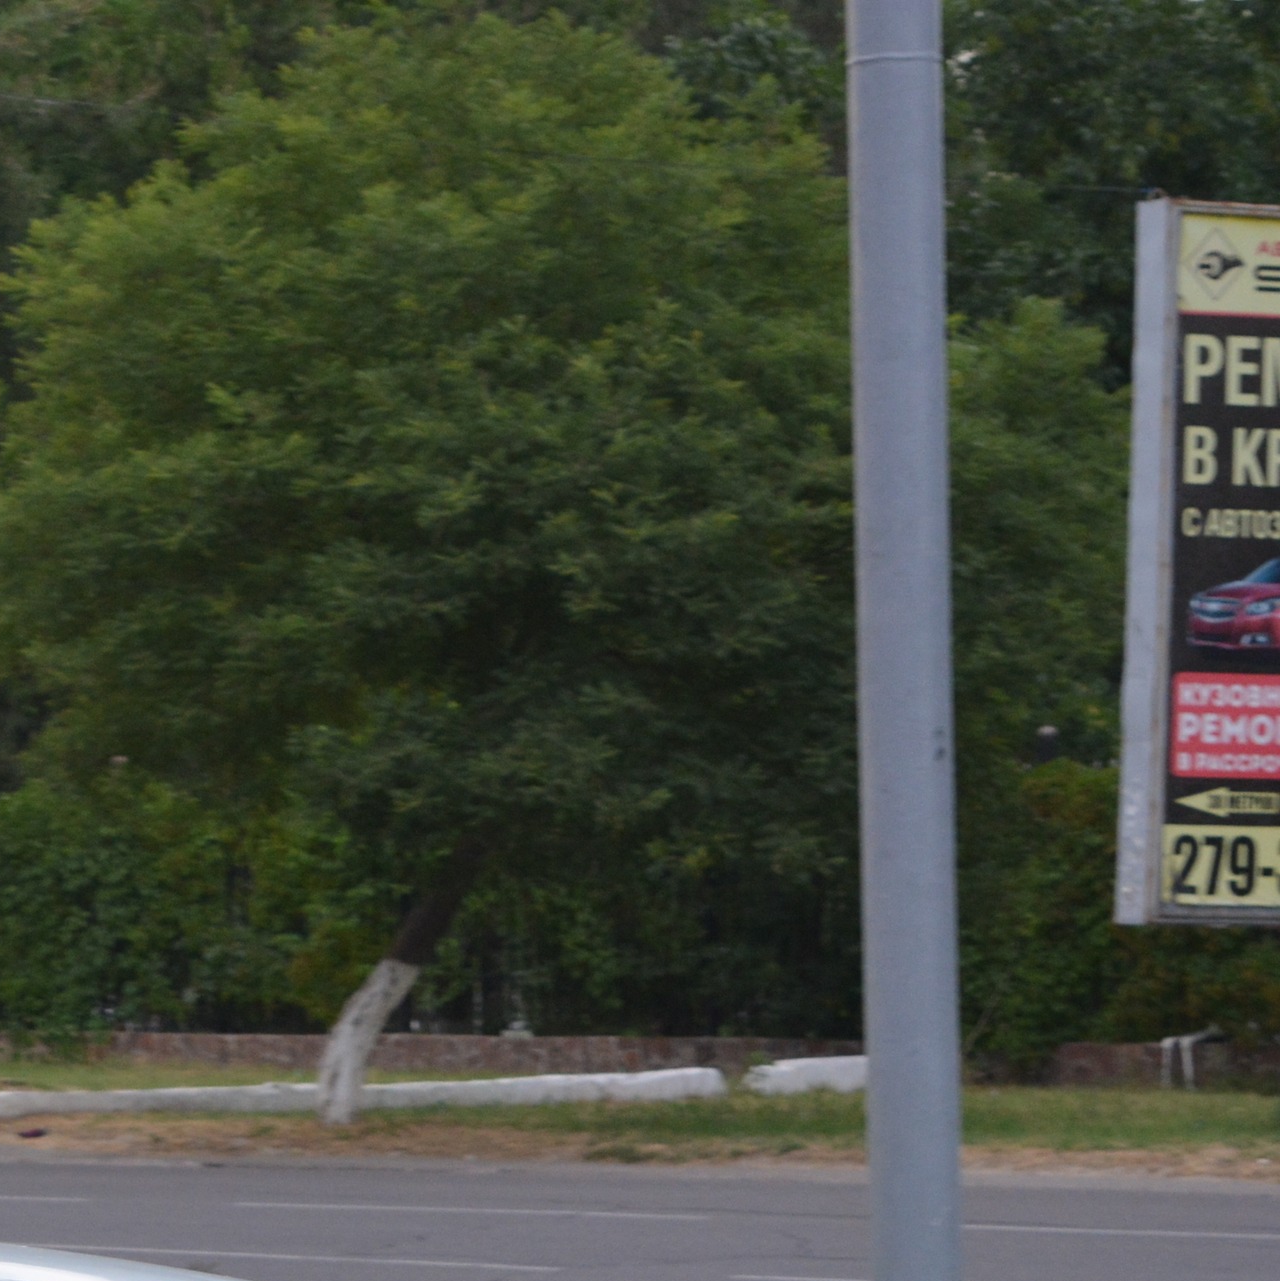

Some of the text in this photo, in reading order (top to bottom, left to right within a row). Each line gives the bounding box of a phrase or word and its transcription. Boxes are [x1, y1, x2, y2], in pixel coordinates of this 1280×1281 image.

[1182, 426, 1218, 485] В
[1178, 712, 1280, 746] РЕМО
[1172, 835, 1280, 896] 279-
